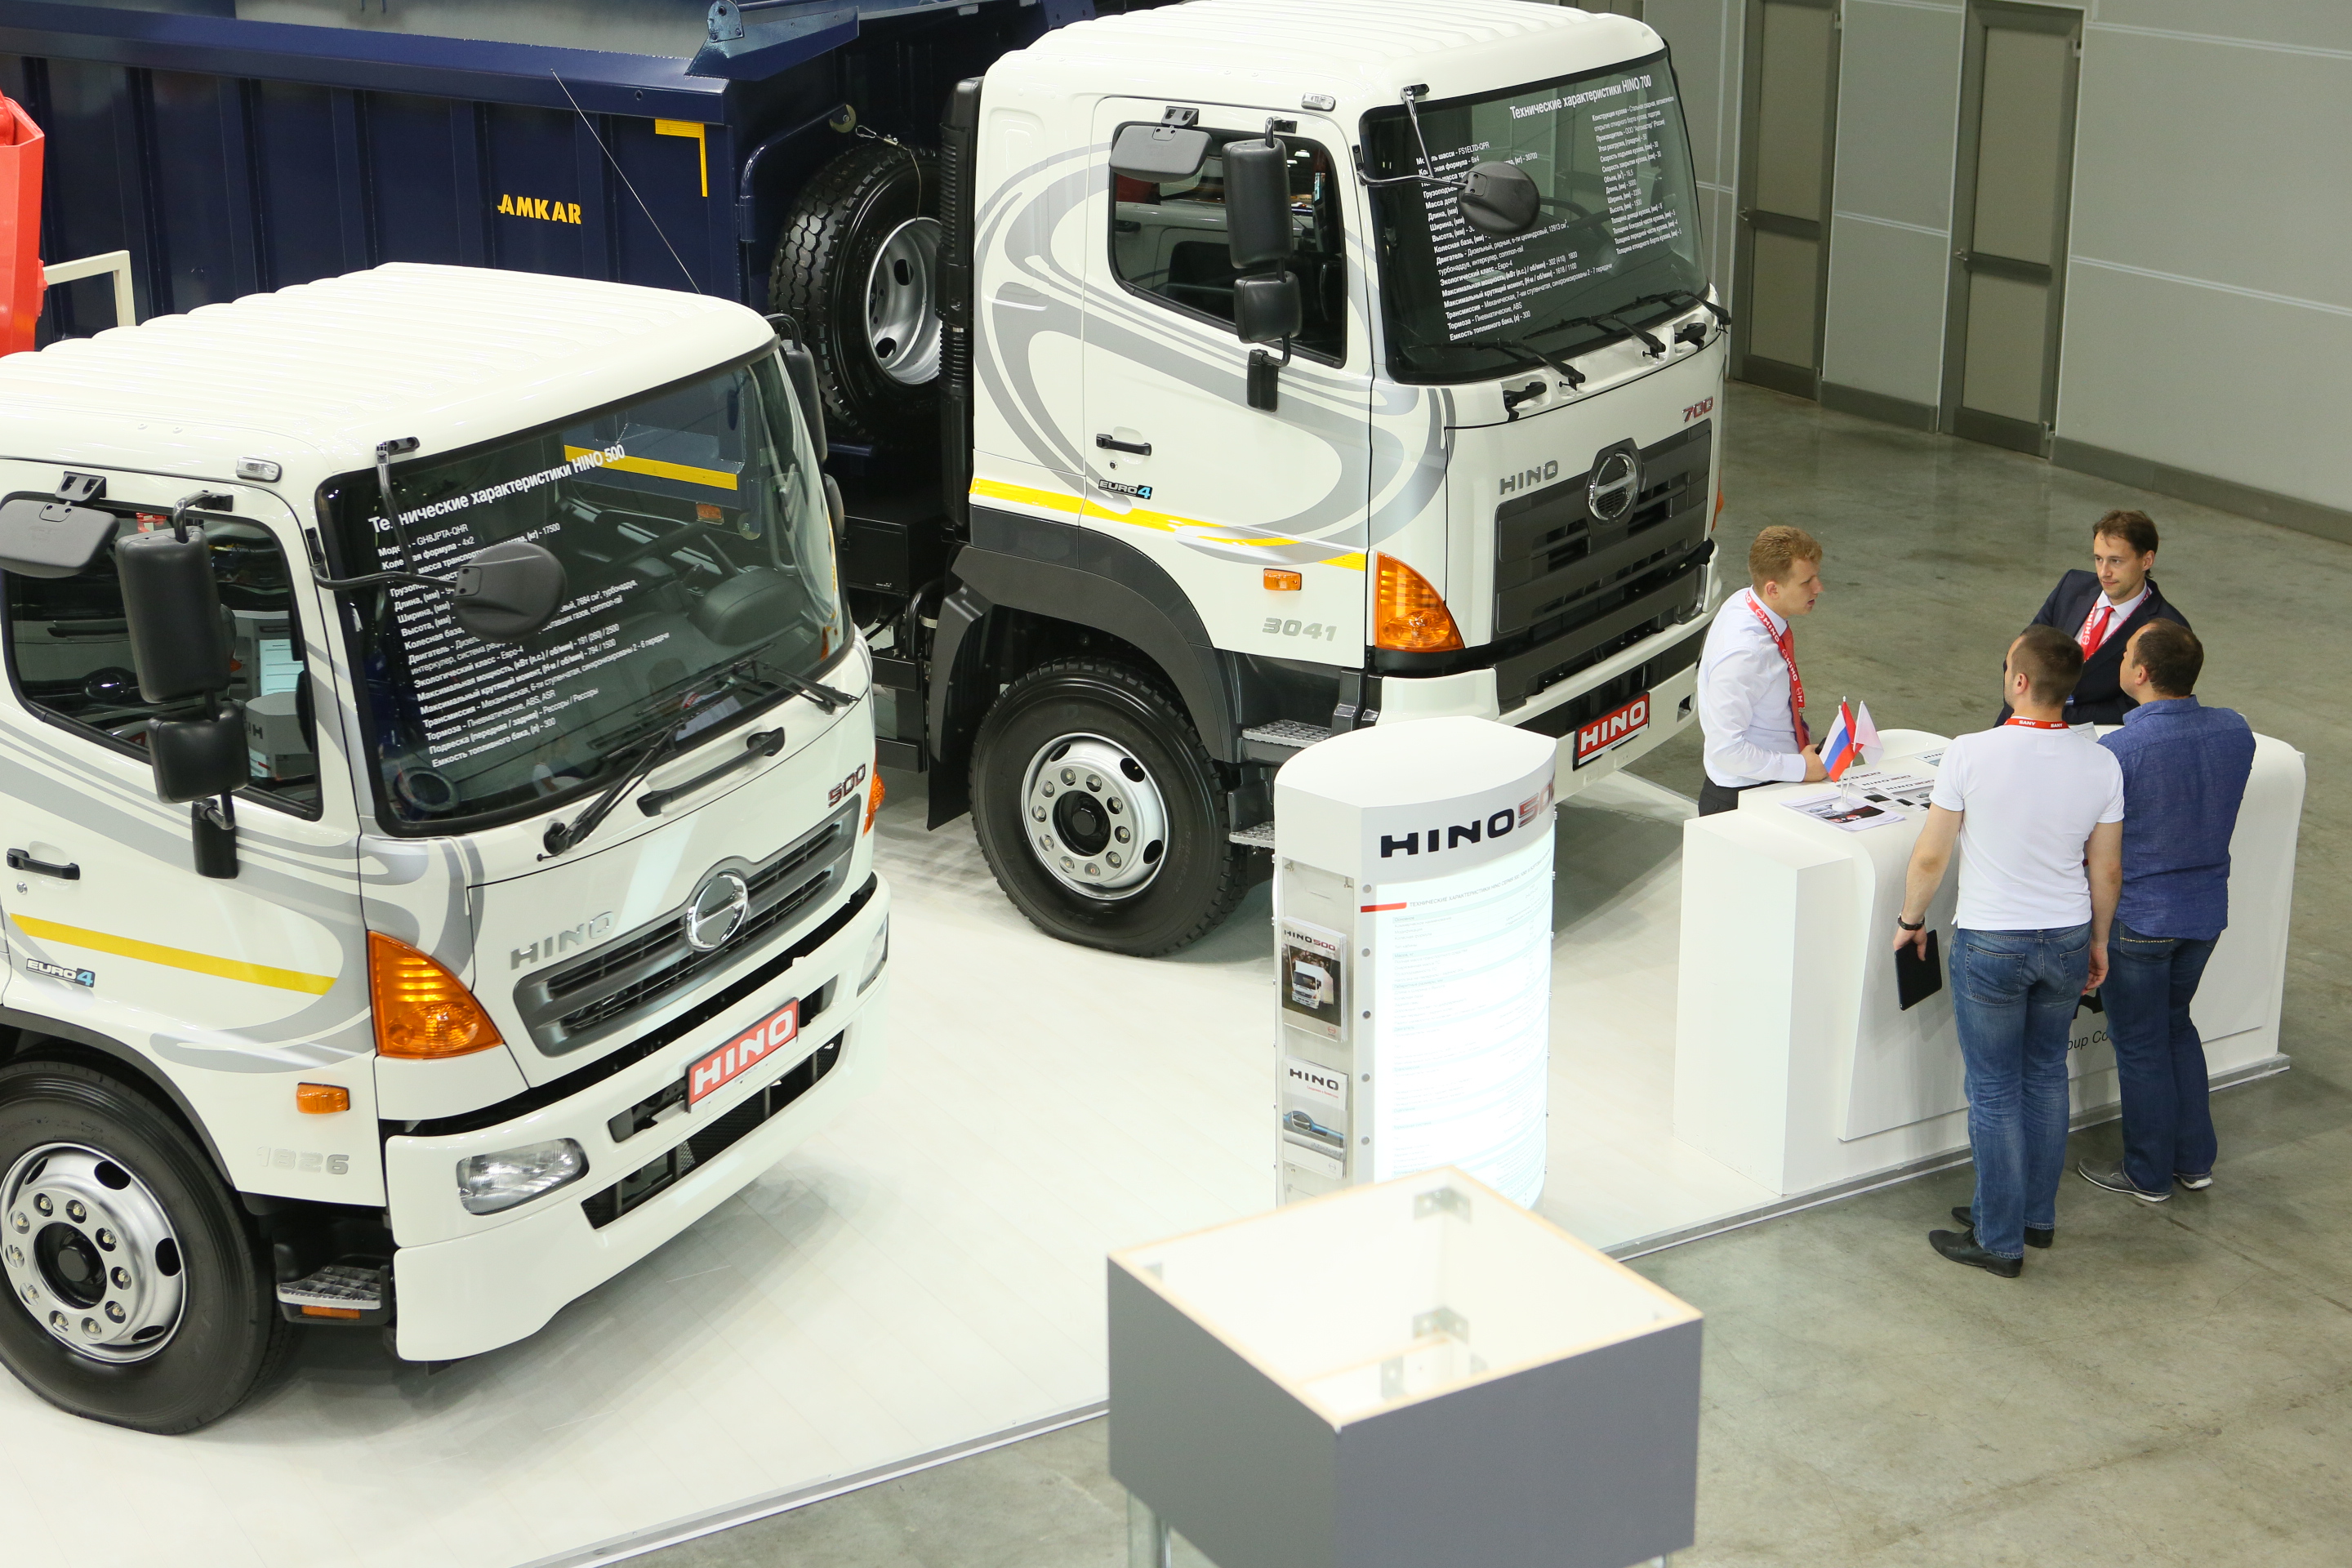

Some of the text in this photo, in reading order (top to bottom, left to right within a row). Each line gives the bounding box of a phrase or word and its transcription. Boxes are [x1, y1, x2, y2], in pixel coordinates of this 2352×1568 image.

[1510, 74, 1651, 118] Технические характеристики HINO 700
[497, 194, 582, 225] AMKAR
[1434, 242, 1459, 253] Колесная
[1437, 252, 1463, 265] Двигатель
[1440, 270, 1480, 286] Экологический
[1480, 266, 1495, 275] класс
[1441, 279, 1481, 296] Максимальная
[1444, 291, 1483, 308] Максимальный
[1446, 305, 1481, 319] Трансмиссия
[1447, 318, 1471, 330] Тормоза
[1512, 301, 1522, 310] ABS
[1450, 329, 1472, 341] Емкость
[1522, 310, 1530, 318] 300
[1682, 396, 1713, 423] 700
[368, 444, 626, 533] Тенические характеристики HINO 500
[1099, 480, 1151, 499] EURO4
[1499, 461, 1557, 496] HINO
[542, 523, 560, 534] 17500
[423, 542, 457, 559] формула
[394, 597, 422, 612] Длина,
[397, 608, 433, 624] Ширина,
[401, 621, 434, 638] Высота,
[404, 626, 465, 650] Колесная база,
[1262, 617, 1337, 642] 3041
[1763, 617, 1780, 643] HINO
[408, 644, 449, 665] Двигатель
[411, 655, 456, 676] интеркулер,
[457, 645, 486, 661] система
[414, 663, 474, 688] Экологический
[474, 656, 496, 669] класс
[501, 645, 523, 660] Евро-4
[420, 689, 479, 715] Максимальный
[479, 676, 515, 695] крутящий
[587, 645, 599, 655] 794
[602, 639, 616, 648] 1500
[1786, 657, 1798, 682] HINO
[417, 676, 475, 702] Максимальная
[423, 705, 475, 728] Трансмиссия
[425, 724, 461, 742] Тормоза
[541, 689, 555, 701] ASR
[1580, 701, 1646, 752] HINO
[429, 735, 470, 755] Подвеска
[432, 751, 467, 768] Емкость
[468, 735, 510, 755] топливного
[511, 728, 530, 740] бака,
[543, 717, 555, 728] 300
[828, 763, 866, 808] 500
[510, 910, 614, 970] HINO
[27, 960, 95, 987] EURO4
[693, 1007, 793, 1096] HINO
[1290, 1068, 1339, 1090] HINO
[256, 1146, 350, 1175] 1826
